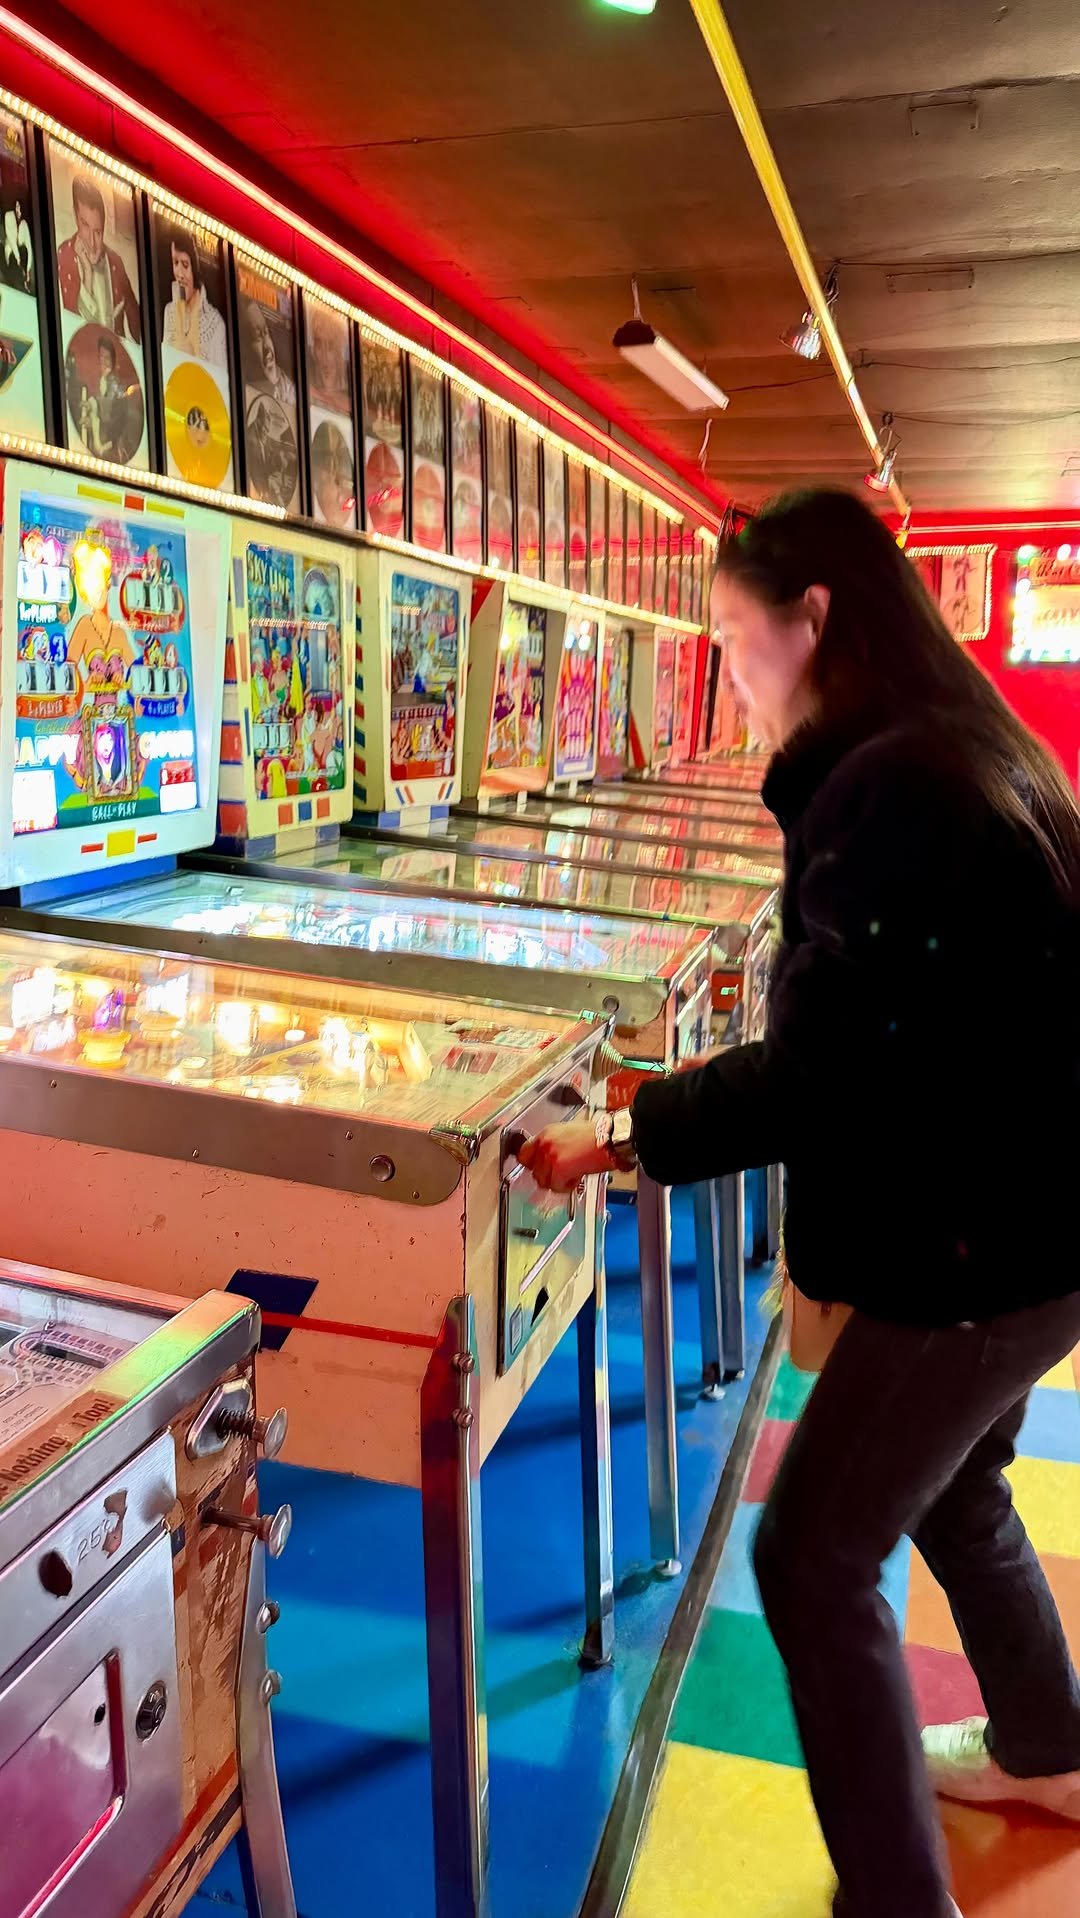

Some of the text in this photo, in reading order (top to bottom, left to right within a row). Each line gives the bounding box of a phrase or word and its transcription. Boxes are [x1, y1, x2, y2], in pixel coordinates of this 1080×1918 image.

[54, 635, 65, 663] 3
[91, 805, 113, 822] BALL
[117, 802, 137, 817] PLAY
[0, 1435, 72, 1482] Nothing
[72, 1398, 115, 1422] Top!
